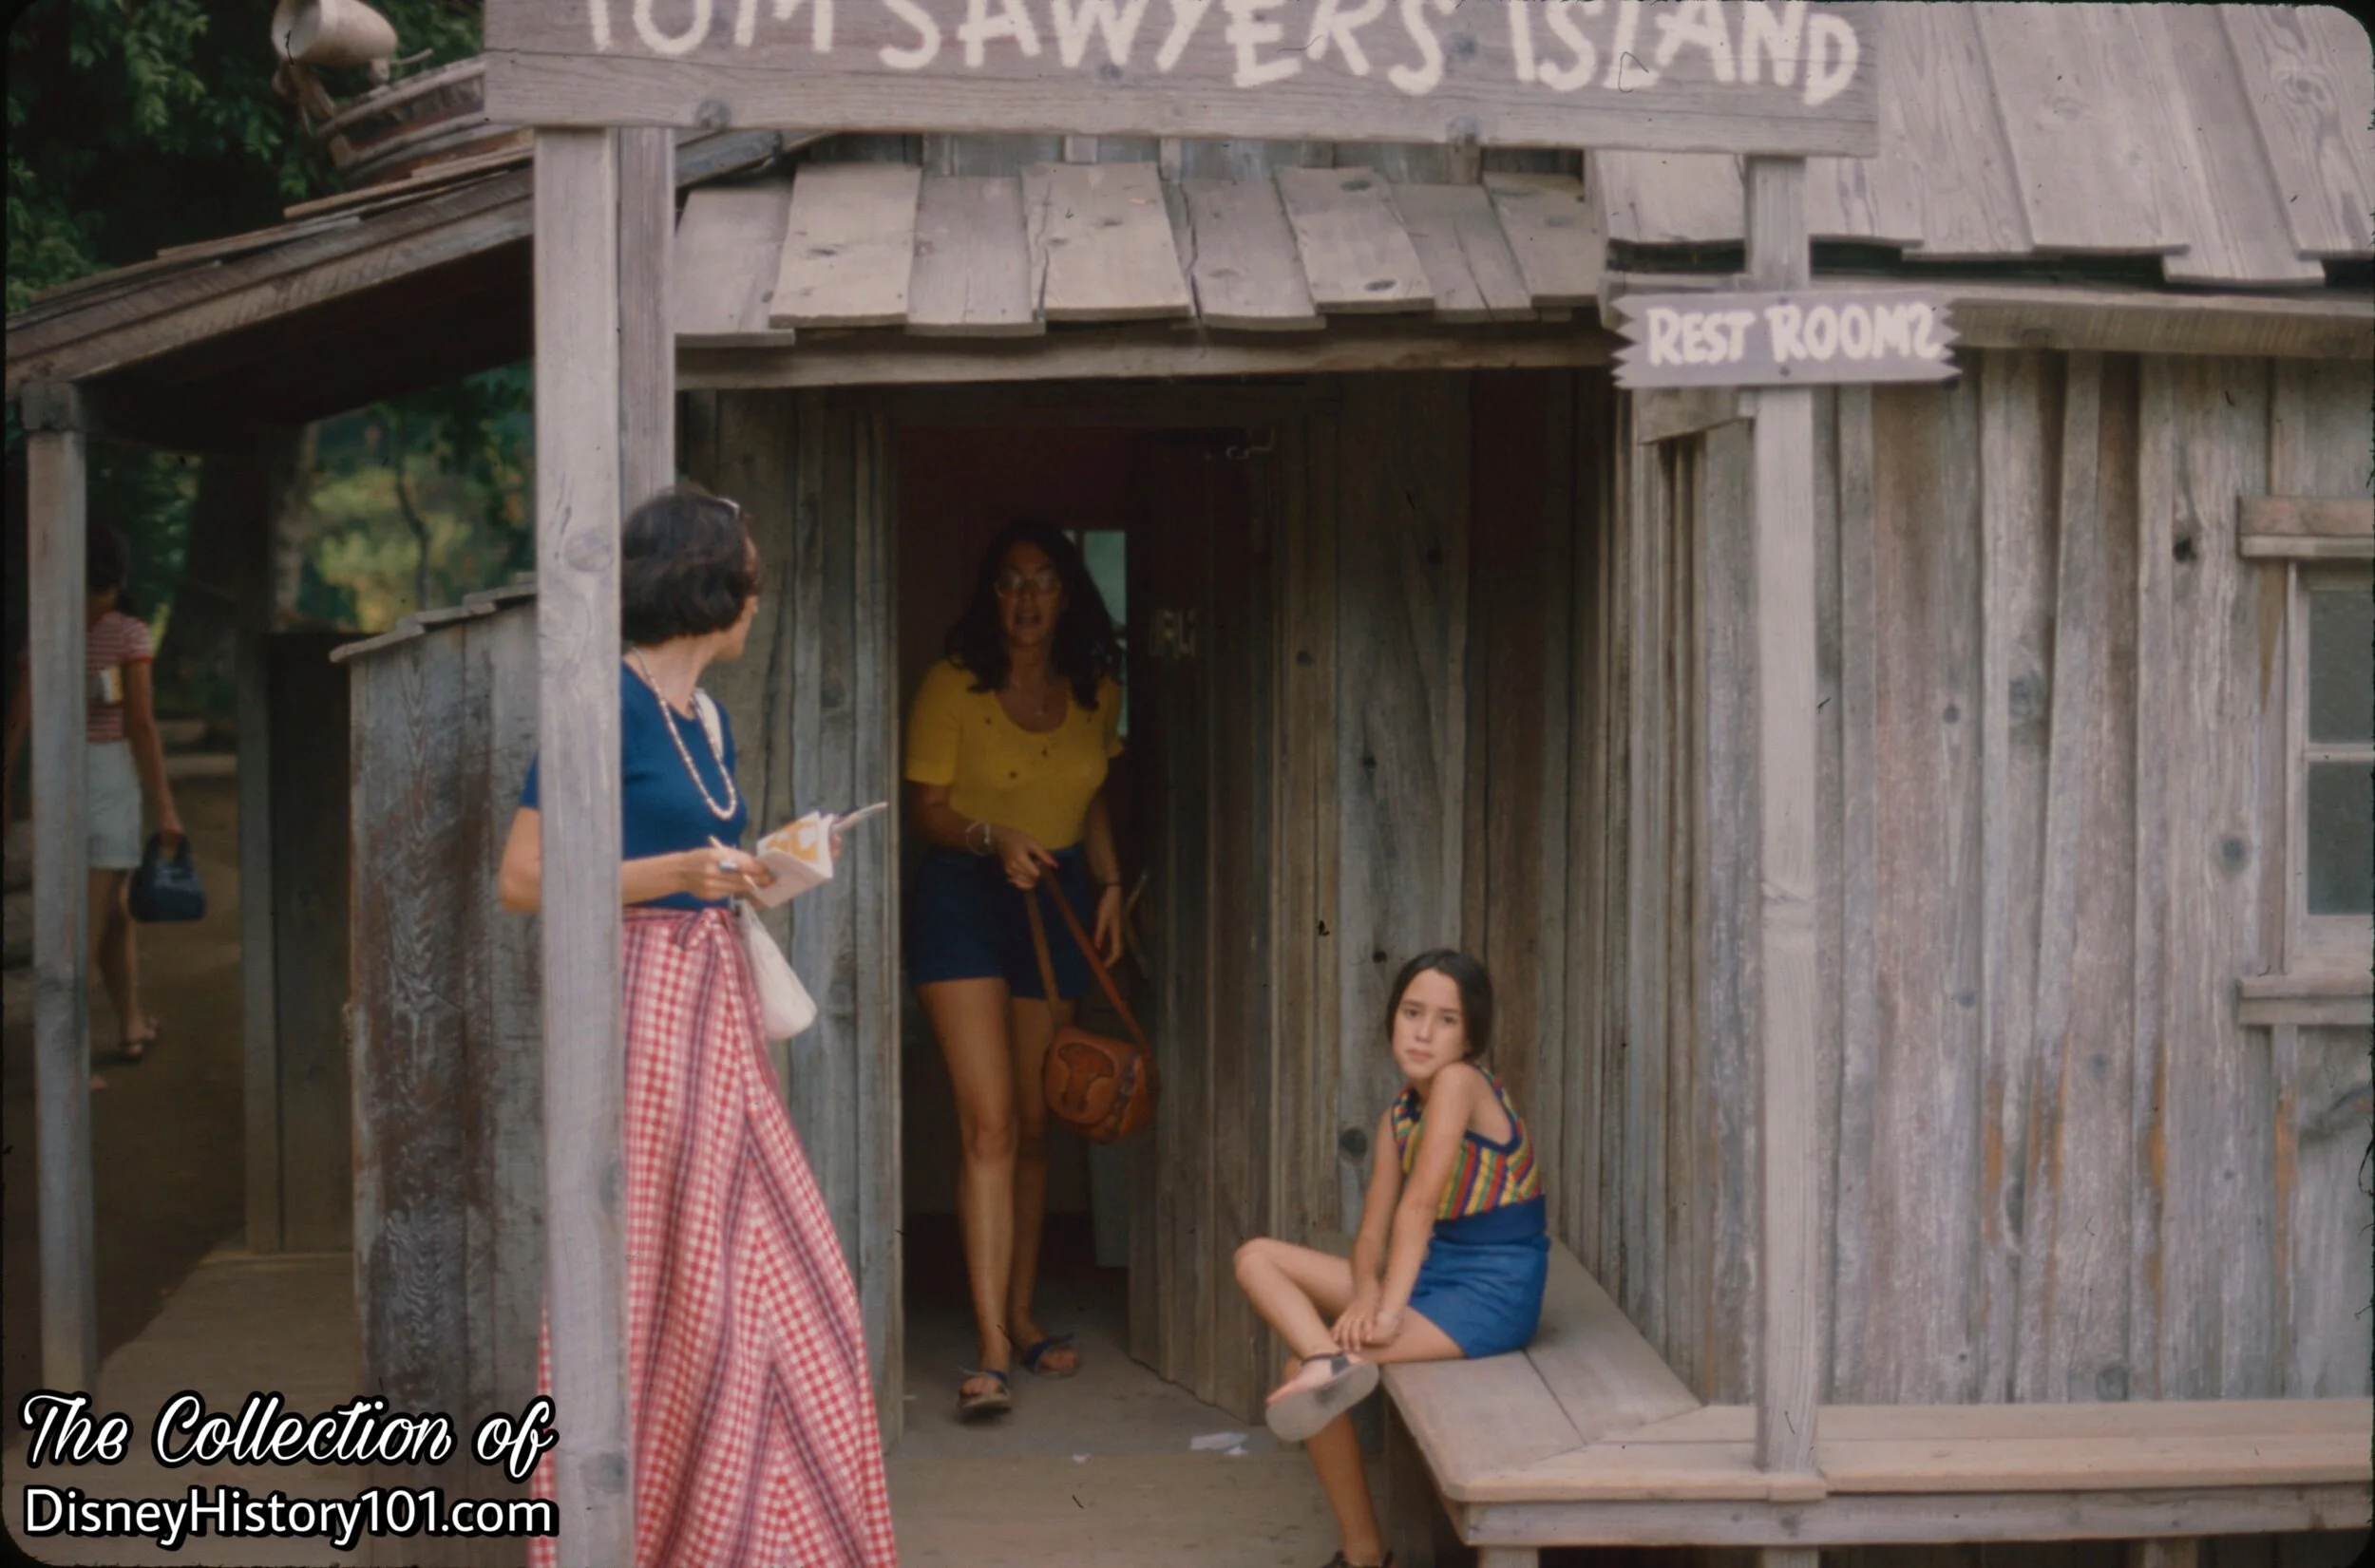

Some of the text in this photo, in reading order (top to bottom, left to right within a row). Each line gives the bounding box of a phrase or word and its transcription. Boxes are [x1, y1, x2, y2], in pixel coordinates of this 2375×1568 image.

[878, 0, 1444, 95] SAWYERS
[1508, 0, 1859, 105] ISLAND
[1646, 307, 1758, 367] REST
